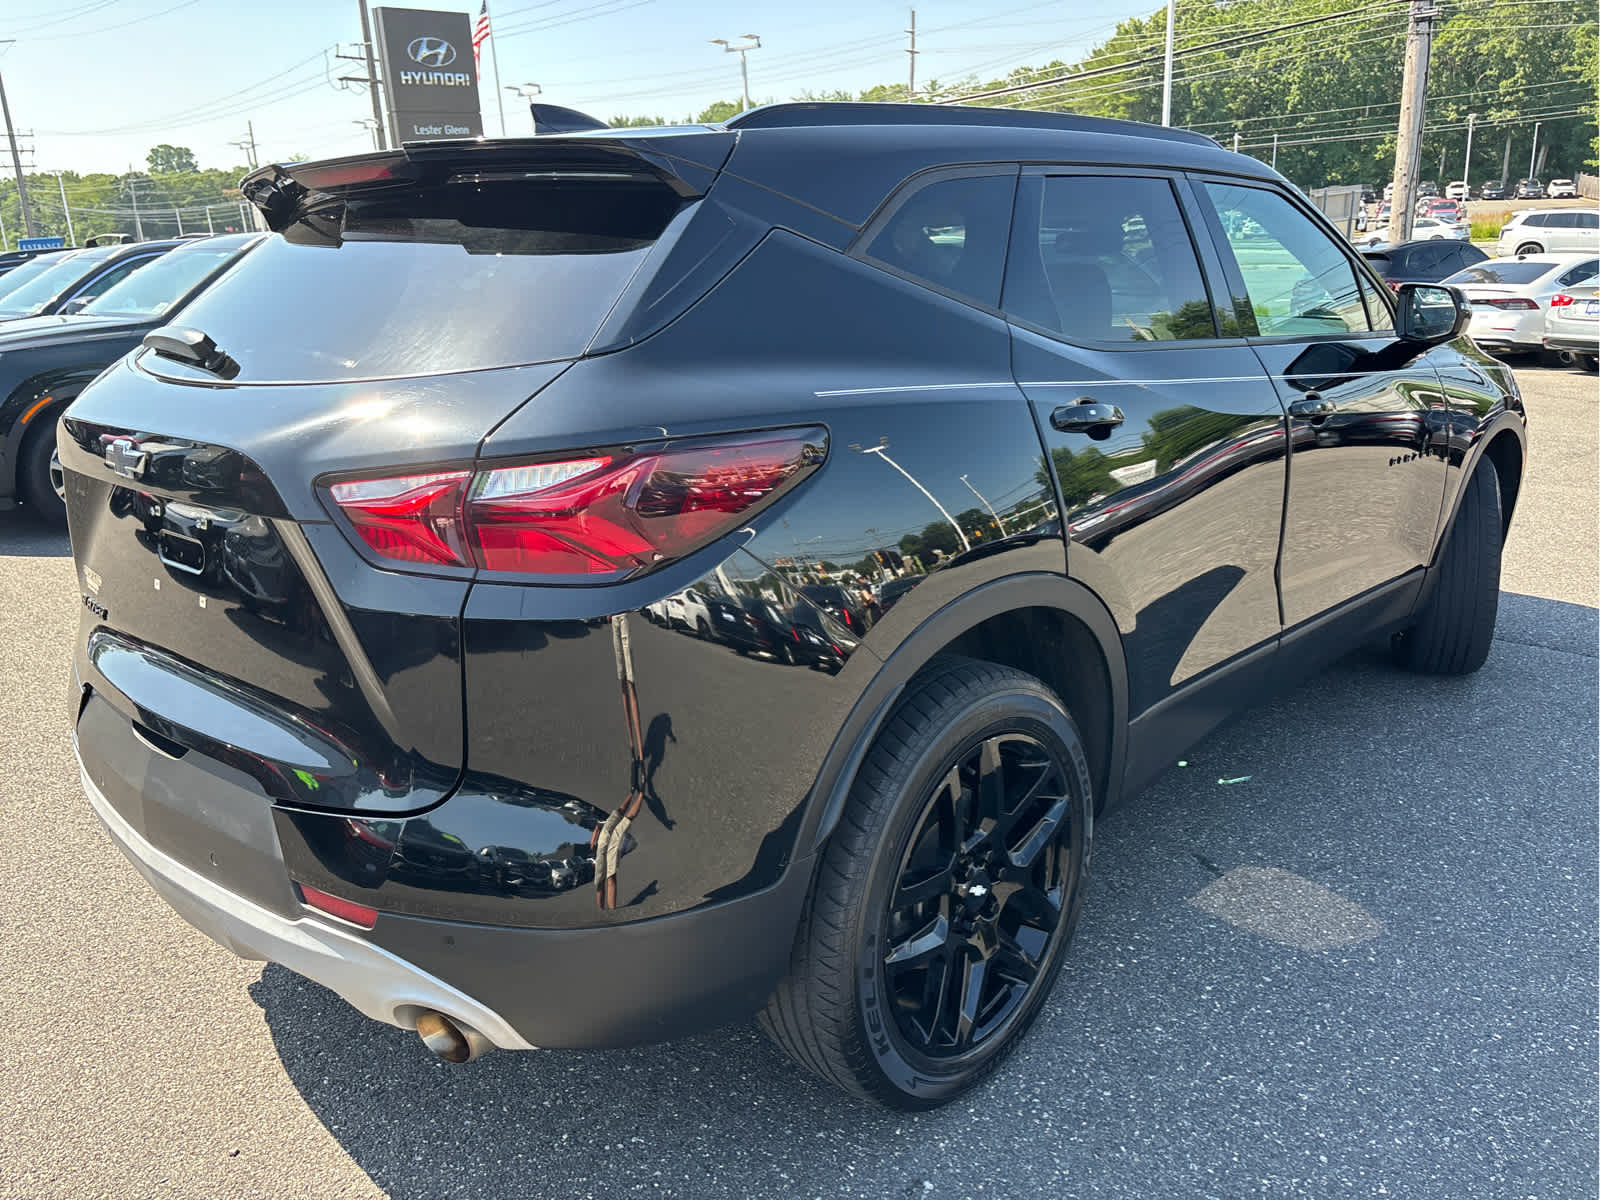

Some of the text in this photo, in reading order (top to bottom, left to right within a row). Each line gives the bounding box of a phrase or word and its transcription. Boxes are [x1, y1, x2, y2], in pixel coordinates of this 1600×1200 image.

[400, 71, 470, 86] HYUNDAI
[413, 125, 470, 135] Lester Glenn
